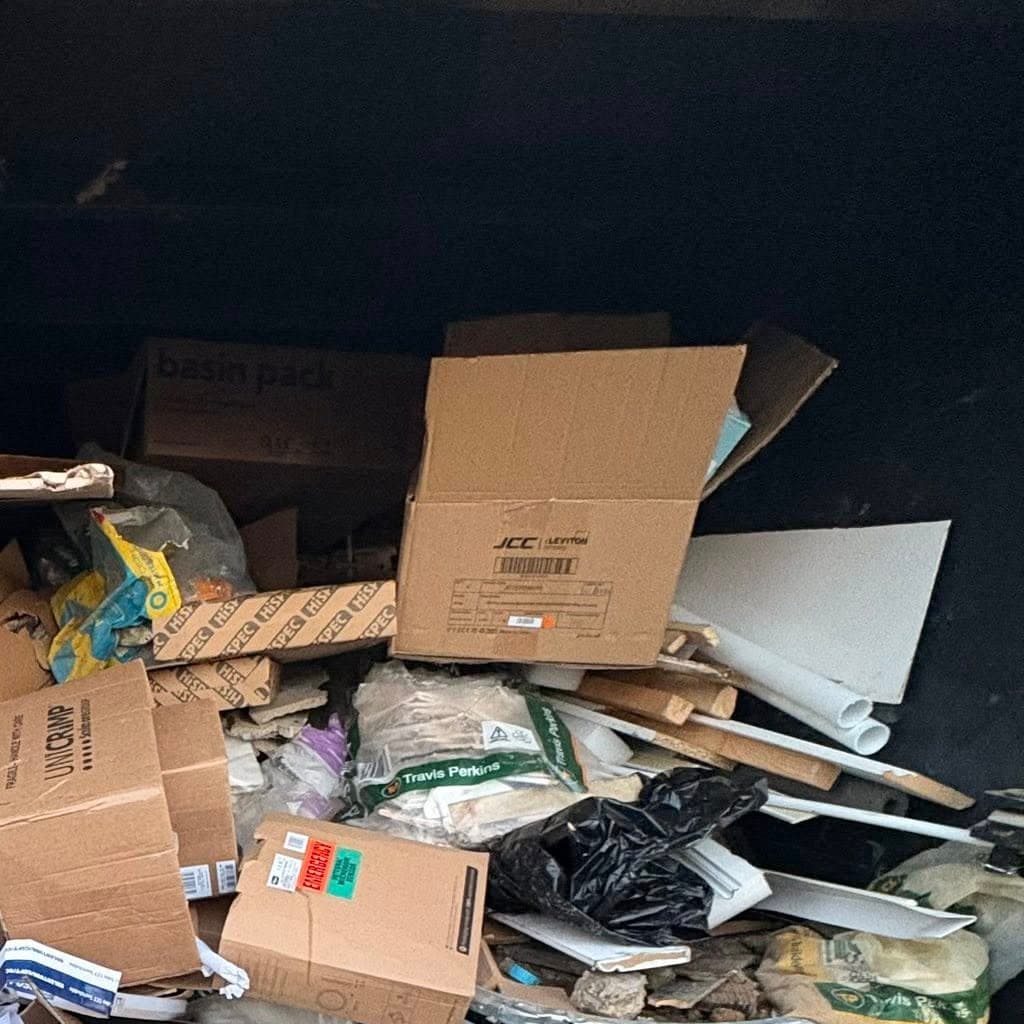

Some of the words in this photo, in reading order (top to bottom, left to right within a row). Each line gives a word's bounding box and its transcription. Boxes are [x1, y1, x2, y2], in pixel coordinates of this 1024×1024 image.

[157, 349, 247, 384] basin
[493, 537, 540, 550] JCC
[548, 536, 588, 546] LEVITON
[45, 705, 75, 780] UNICRIMP
[402, 771, 445, 785] Travis
[448, 763, 500, 778] Perkins
[303, 840, 332, 891] EMERGENCY
